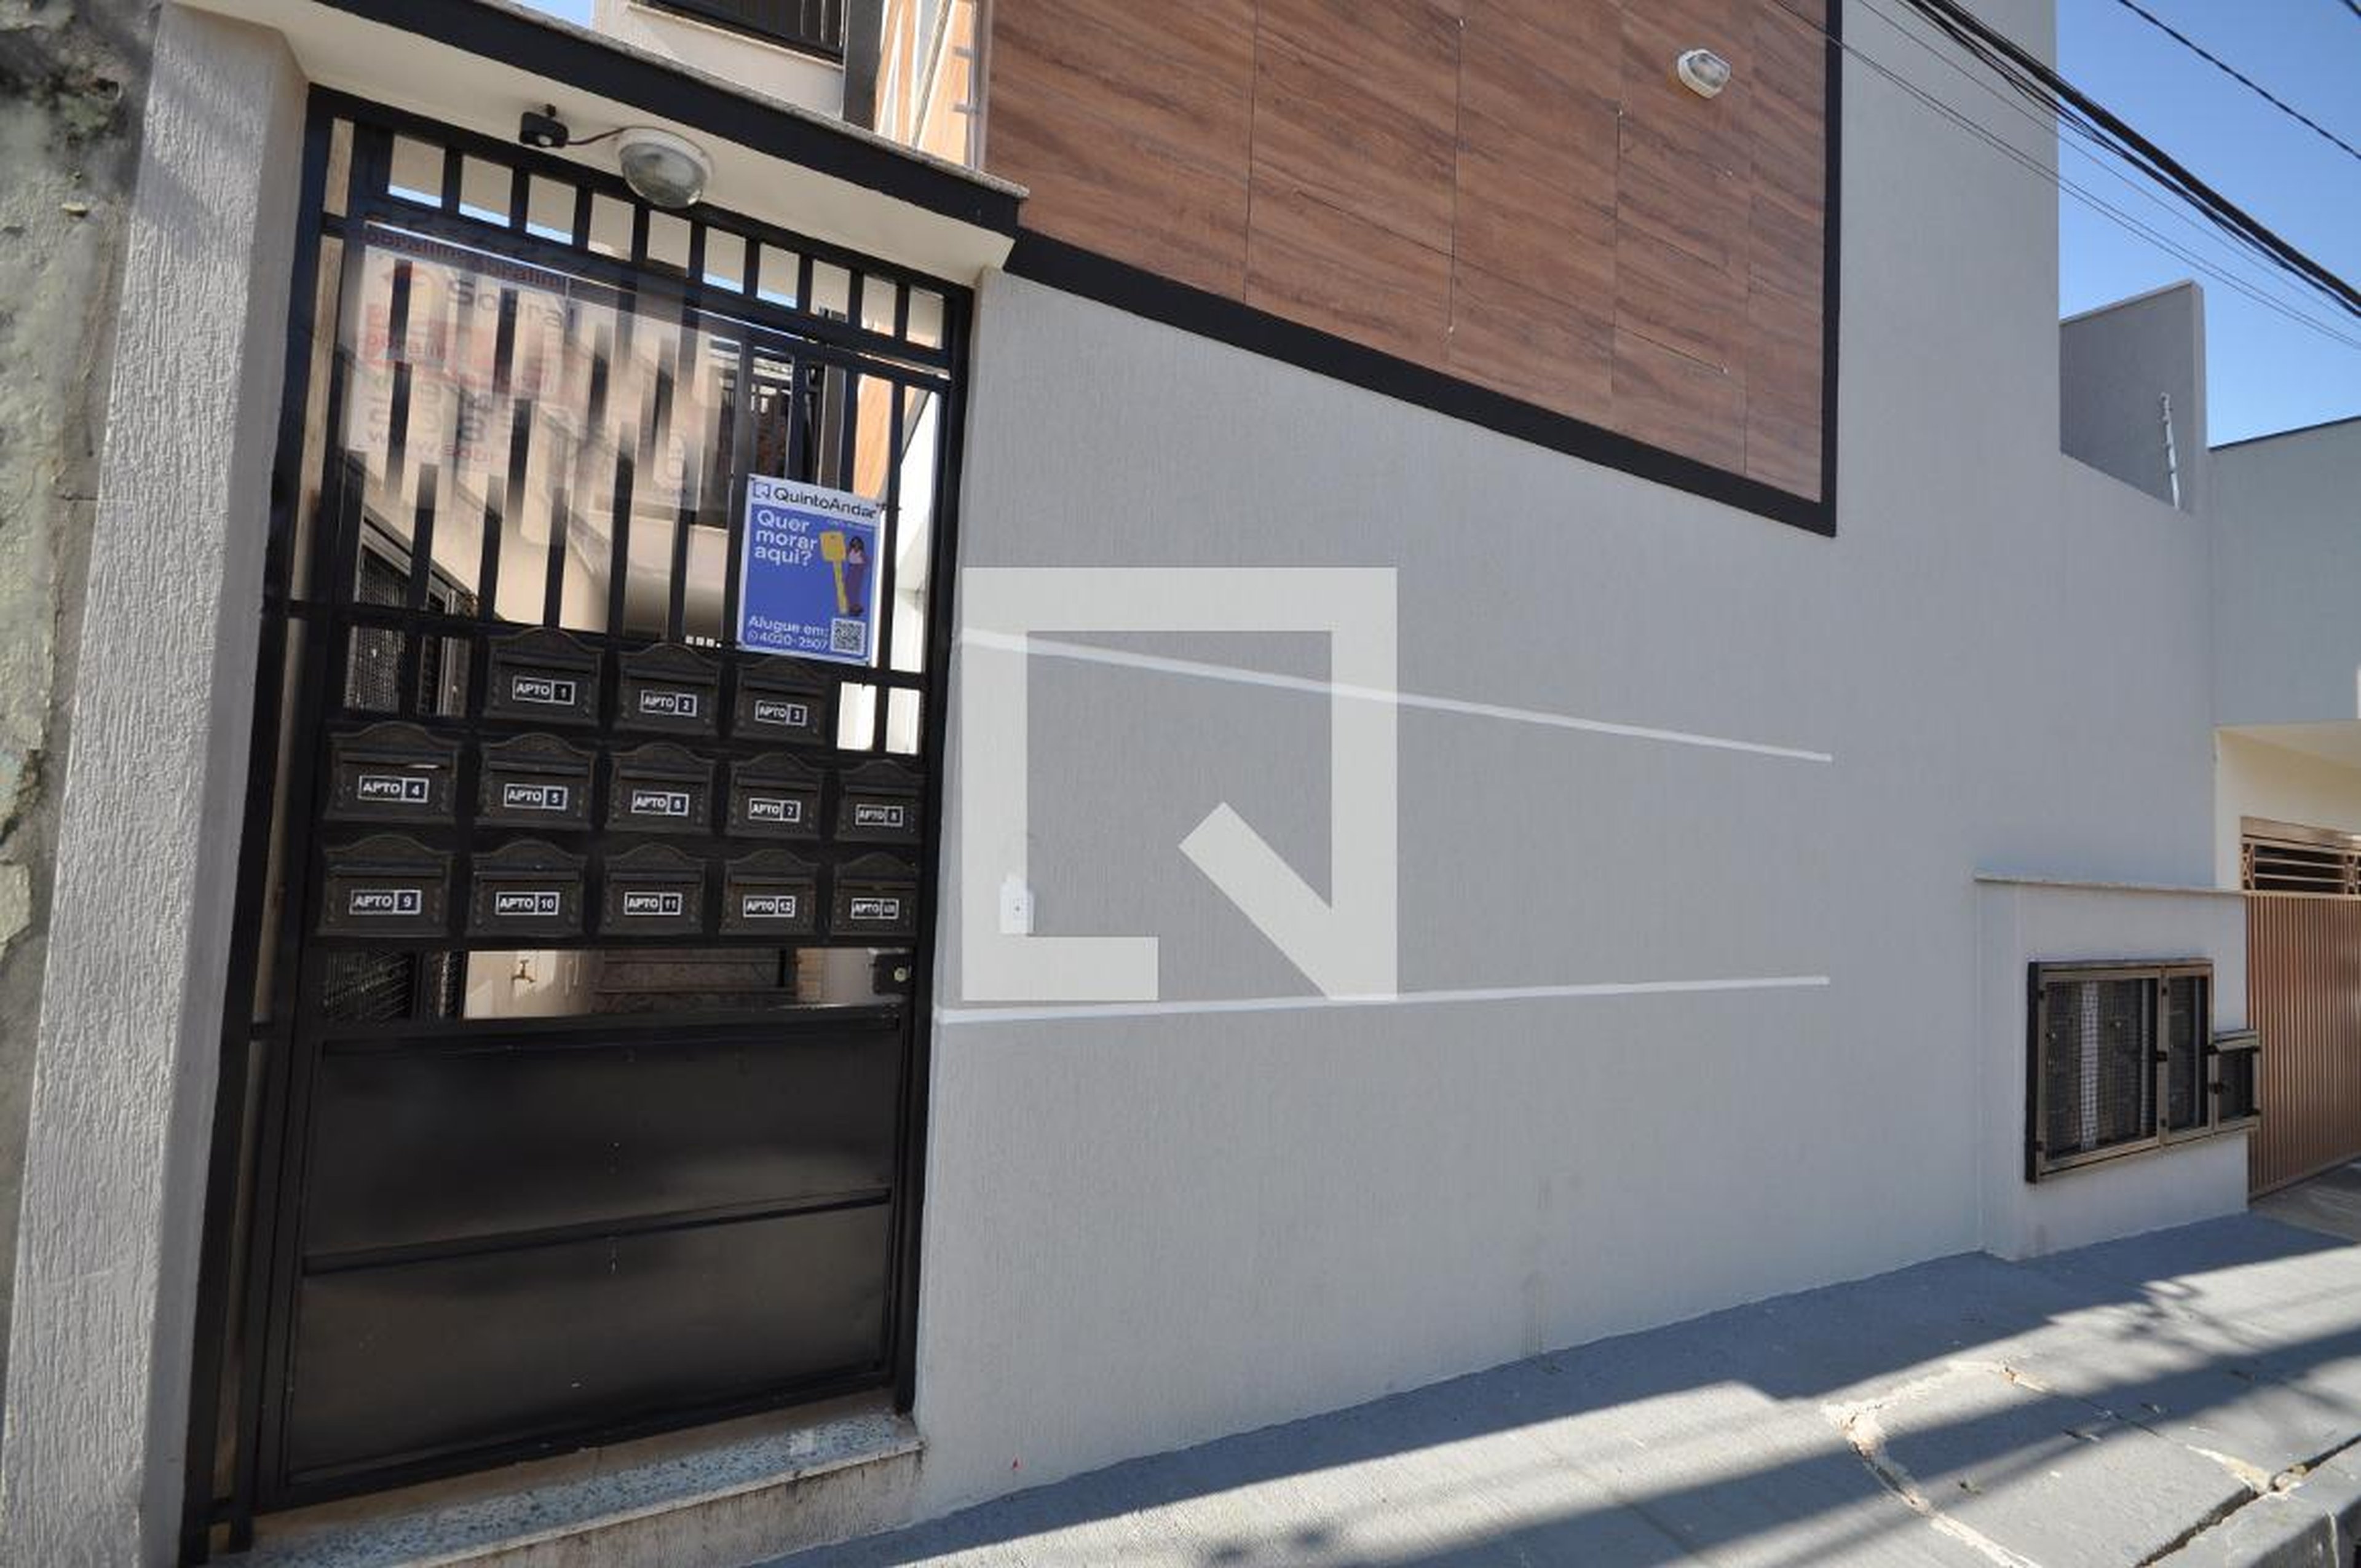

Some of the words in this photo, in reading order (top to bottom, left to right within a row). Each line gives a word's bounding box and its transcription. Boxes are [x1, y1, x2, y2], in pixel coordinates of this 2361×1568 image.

[774, 487, 876, 519] QuintoAndar
[757, 510, 810, 532] Quer
[756, 530, 818, 550] morar
[754, 546, 812, 566] aqui?
[748, 616, 800, 634] Alugue
[804, 623, 829, 637] em:
[516, 683, 550, 697] APTO
[644, 695, 675, 709] APTO
[759, 706, 787, 719] APTO
[362, 782, 400, 794] APTO
[508, 791, 542, 803] APTO
[635, 795, 667, 809] APTO
[752, 803, 781, 815] APTO
[858, 808, 884, 821] APTO
[354, 896, 394, 907] APTO
[500, 897, 534, 909] APTO
[540, 898, 555, 910] 10
[628, 897, 659, 909] APTO
[664, 899, 677, 910] 11
[746, 899, 775, 912] APTO
[779, 900, 793, 912] 12
[855, 903, 880, 914] APTO
